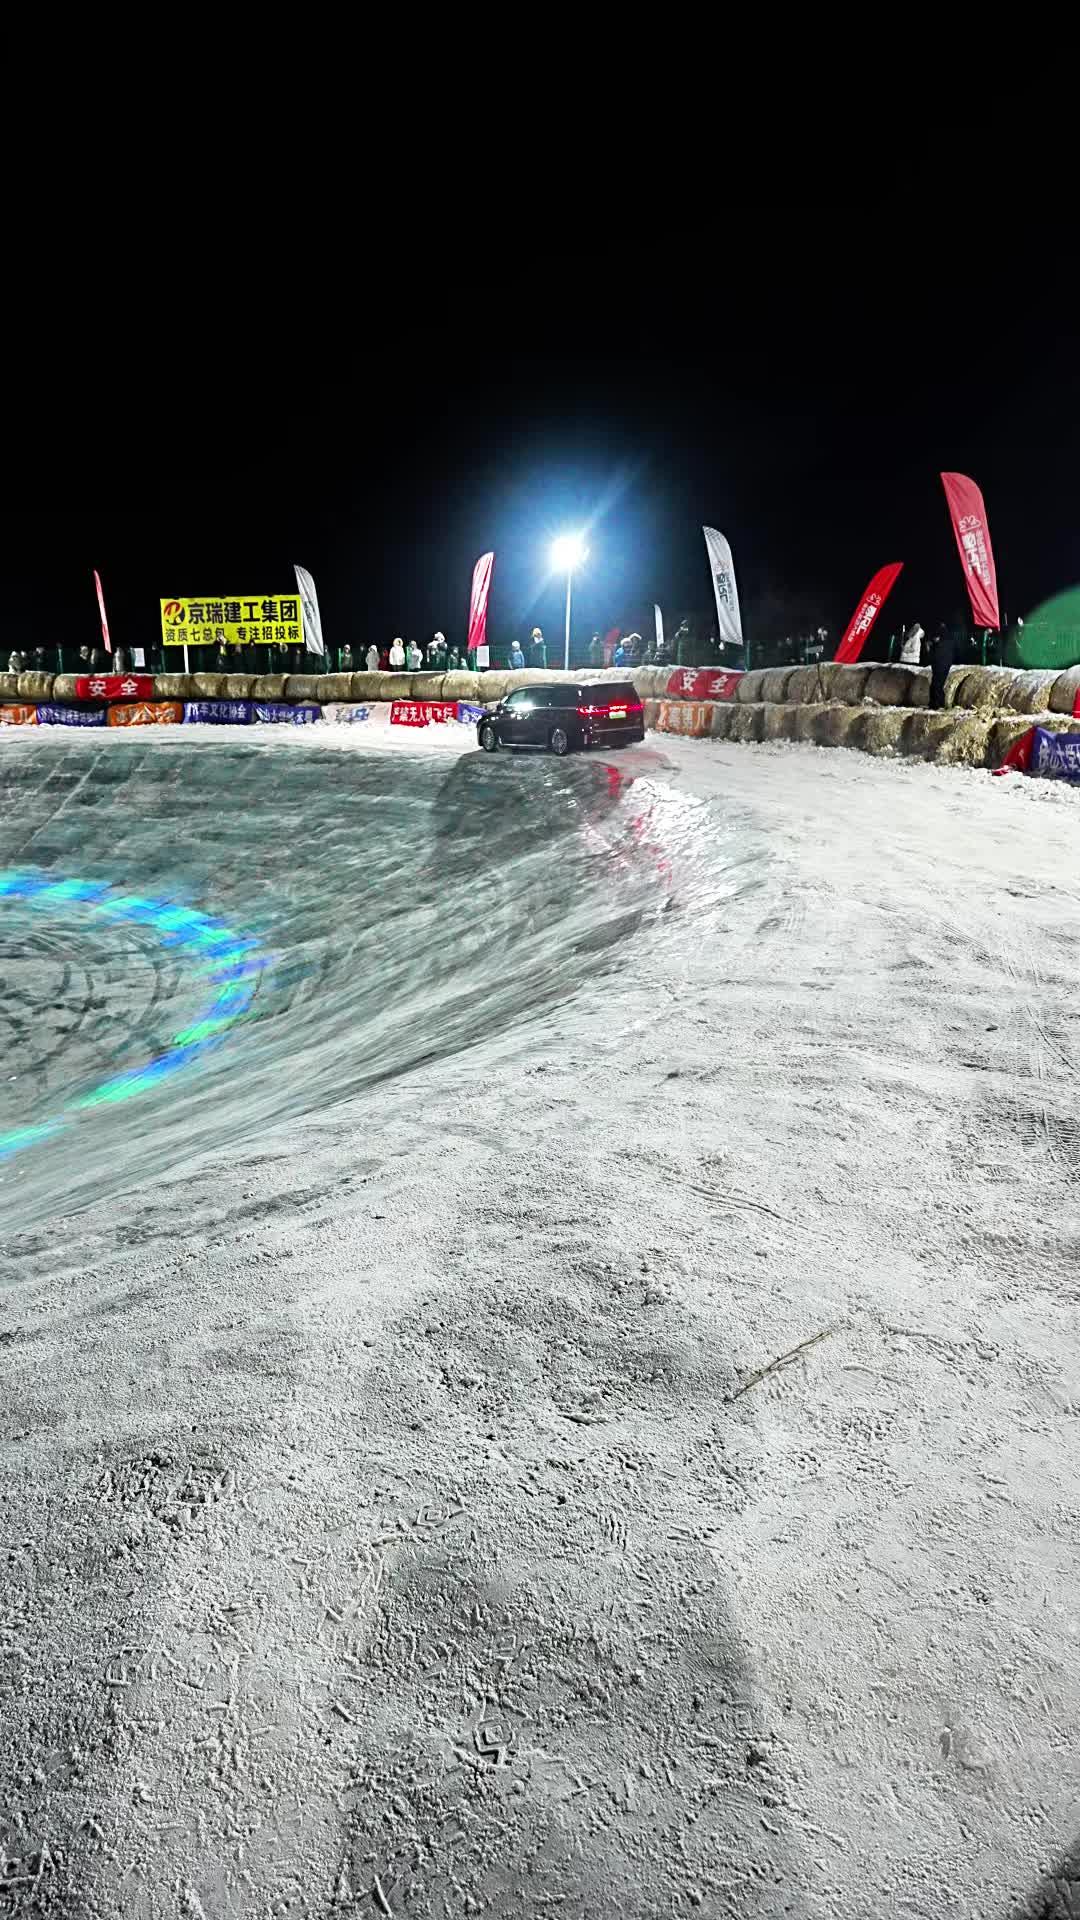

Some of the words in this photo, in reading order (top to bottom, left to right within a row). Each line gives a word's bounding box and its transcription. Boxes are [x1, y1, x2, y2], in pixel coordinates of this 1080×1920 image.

[188, 600, 298, 625] 京瑞建工集团
[237, 625, 300, 641] 专注招投标
[88, 678, 139, 697] 安全
[680, 670, 729, 693] 安全
[391, 706, 453, 722] 严禁无人机飞行
